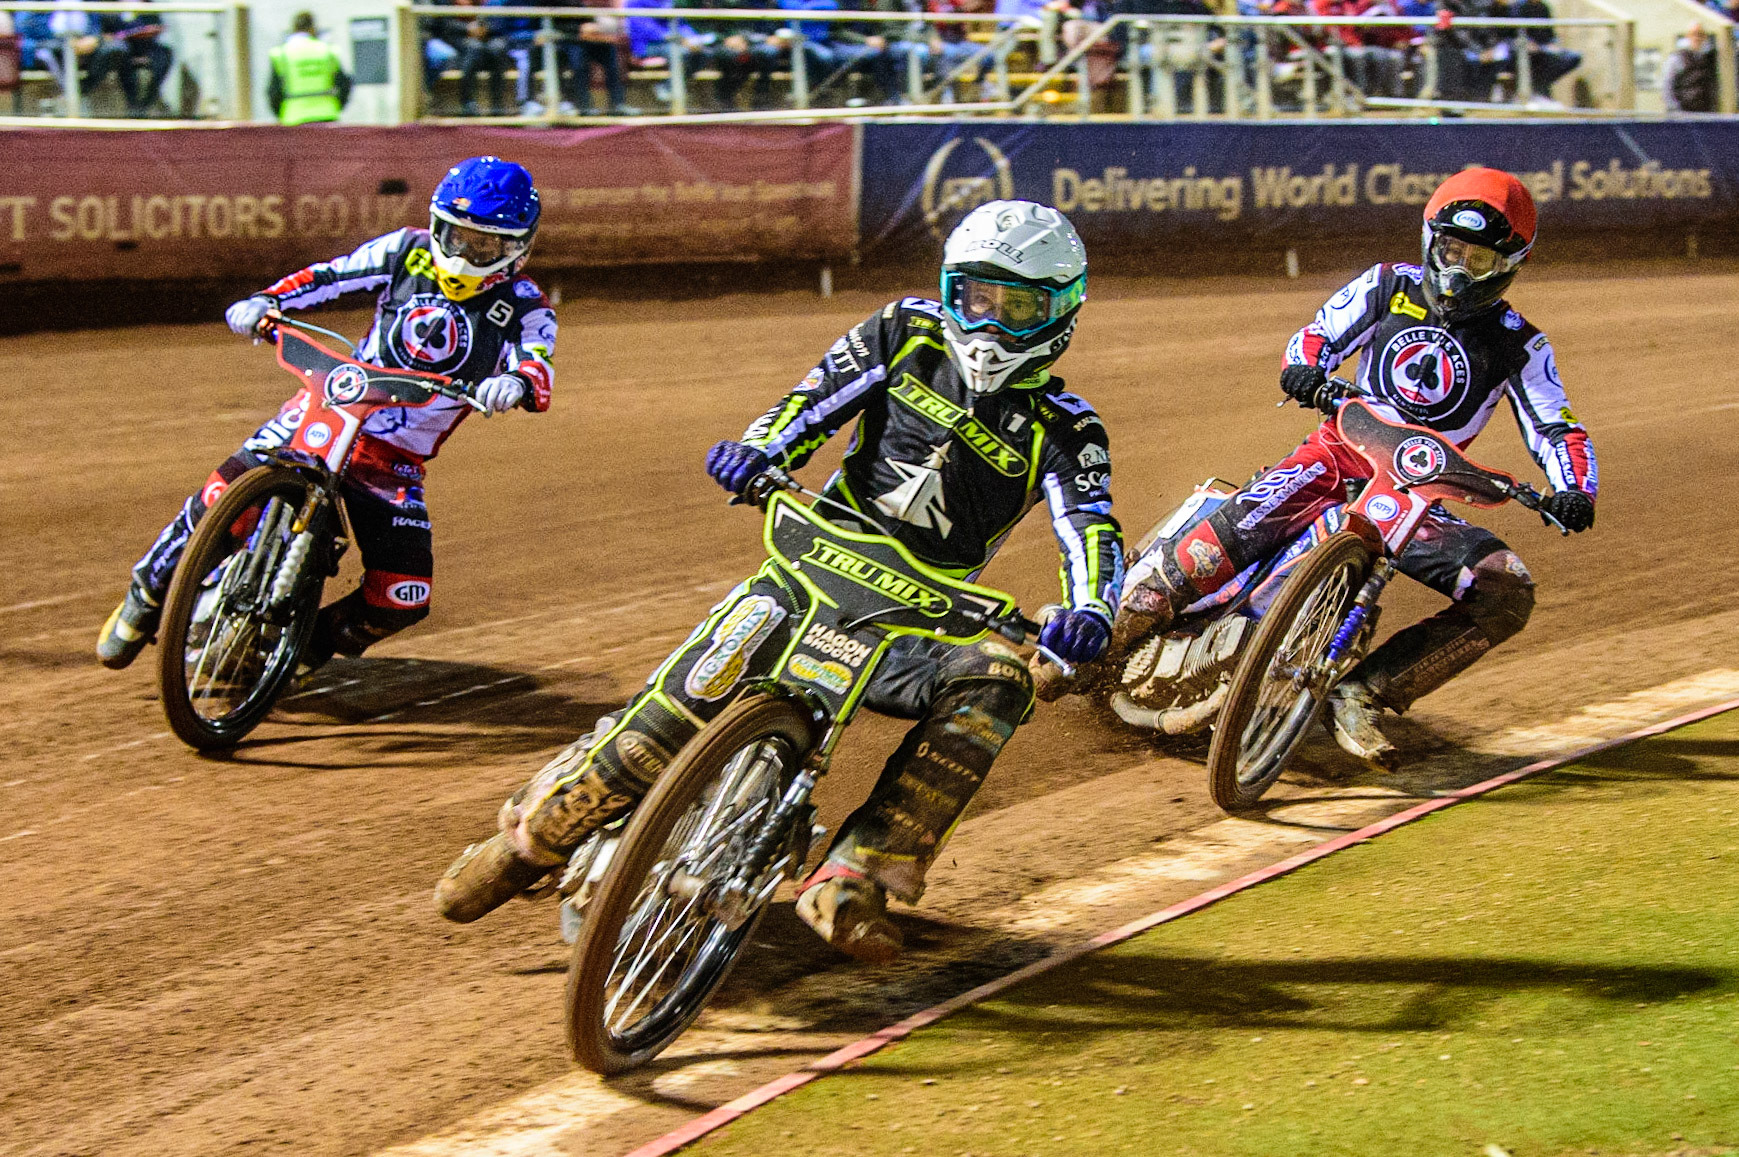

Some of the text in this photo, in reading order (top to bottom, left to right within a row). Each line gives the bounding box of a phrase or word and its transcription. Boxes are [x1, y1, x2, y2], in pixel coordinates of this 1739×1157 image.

[1053, 166, 1243, 221] Delivering
[1251, 165, 1359, 208] World
[1571, 158, 1711, 200] Solutions
[1390, 331, 1426, 353] BELLE
[1450, 354, 1466, 384] ACES
[904, 383, 1020, 471] TRU MIX
[1237, 461, 1327, 531] WESSEXMARINE
[1372, 501, 1393, 515] ATPI
[394, 584, 426, 602] GM
[817, 545, 943, 608] TRU MIX
[801, 634, 864, 668] SHOCKS
[807, 622, 873, 660] HAGON
